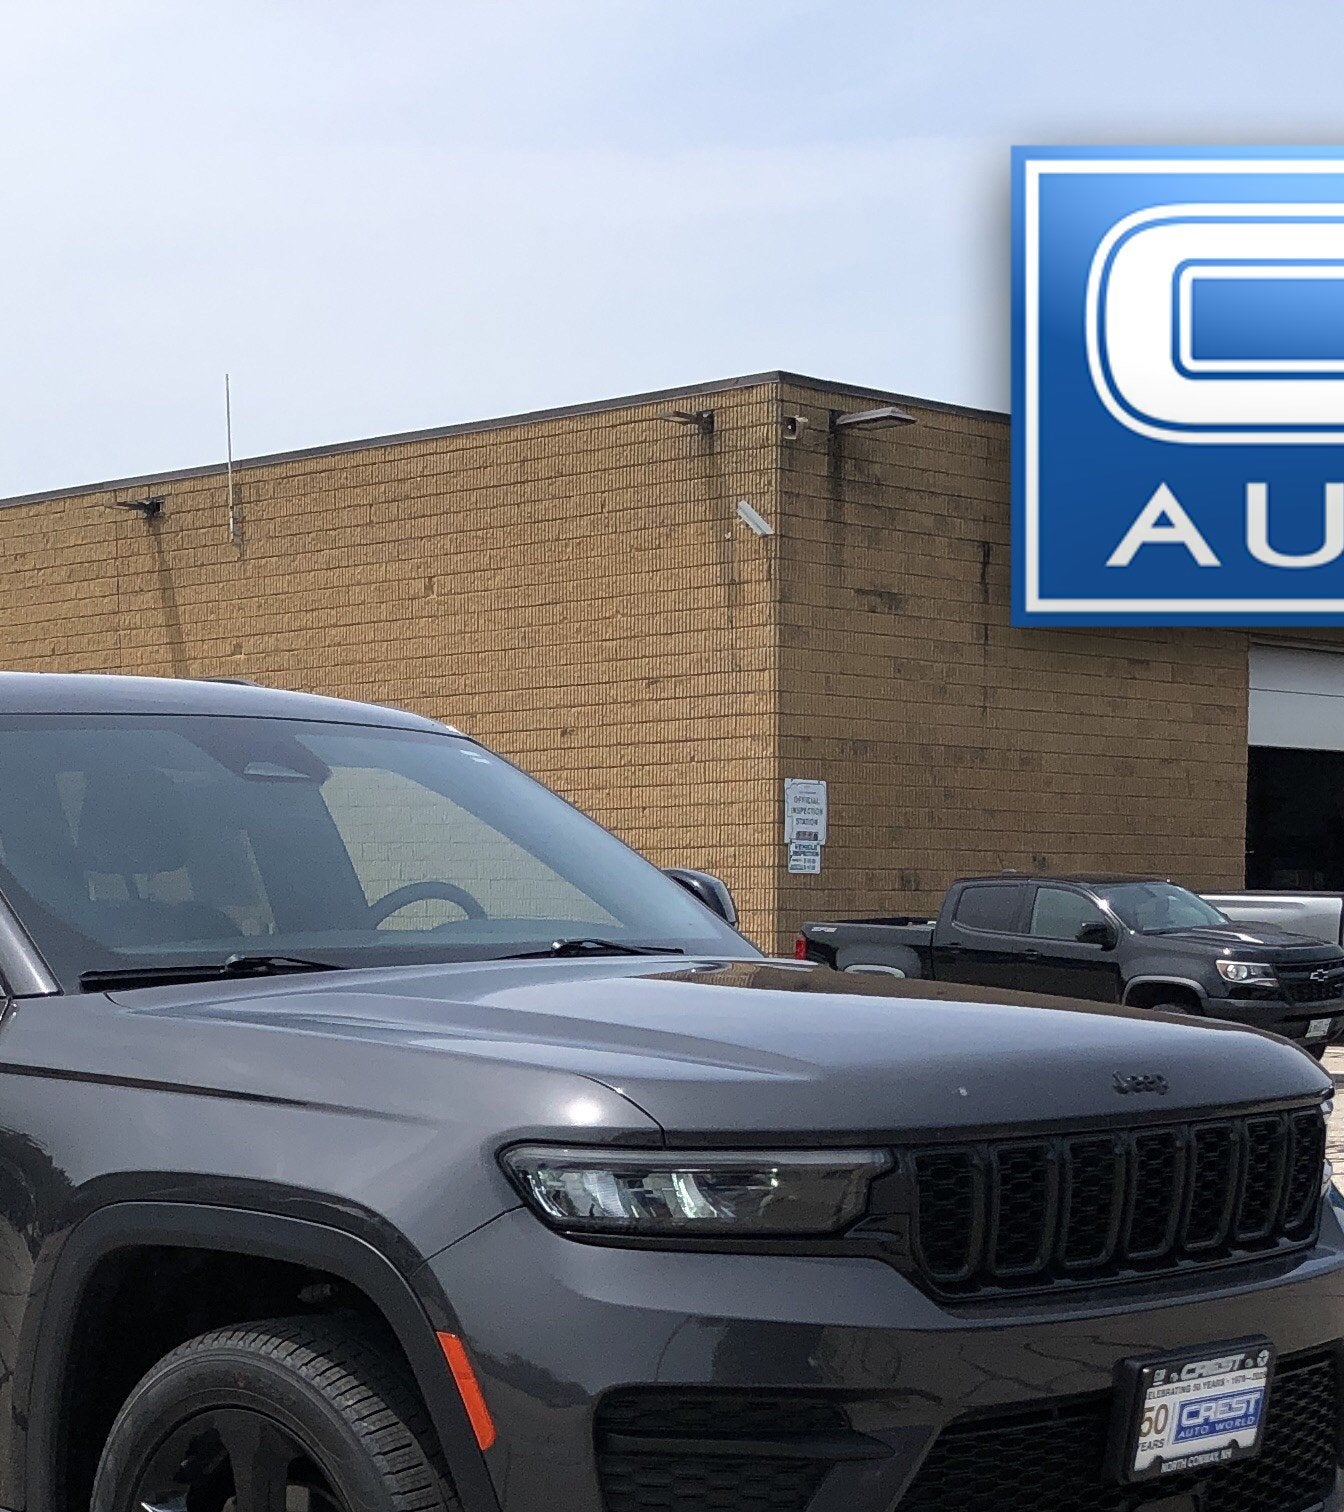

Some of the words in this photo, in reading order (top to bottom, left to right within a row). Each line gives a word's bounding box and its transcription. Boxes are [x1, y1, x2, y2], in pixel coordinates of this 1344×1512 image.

[1139, 1403, 1168, 1437] 50
[1181, 1392, 1260, 1427] CREST
[1178, 1426, 1209, 1438] AUTO
[1215, 1417, 1255, 1430] WORLD
